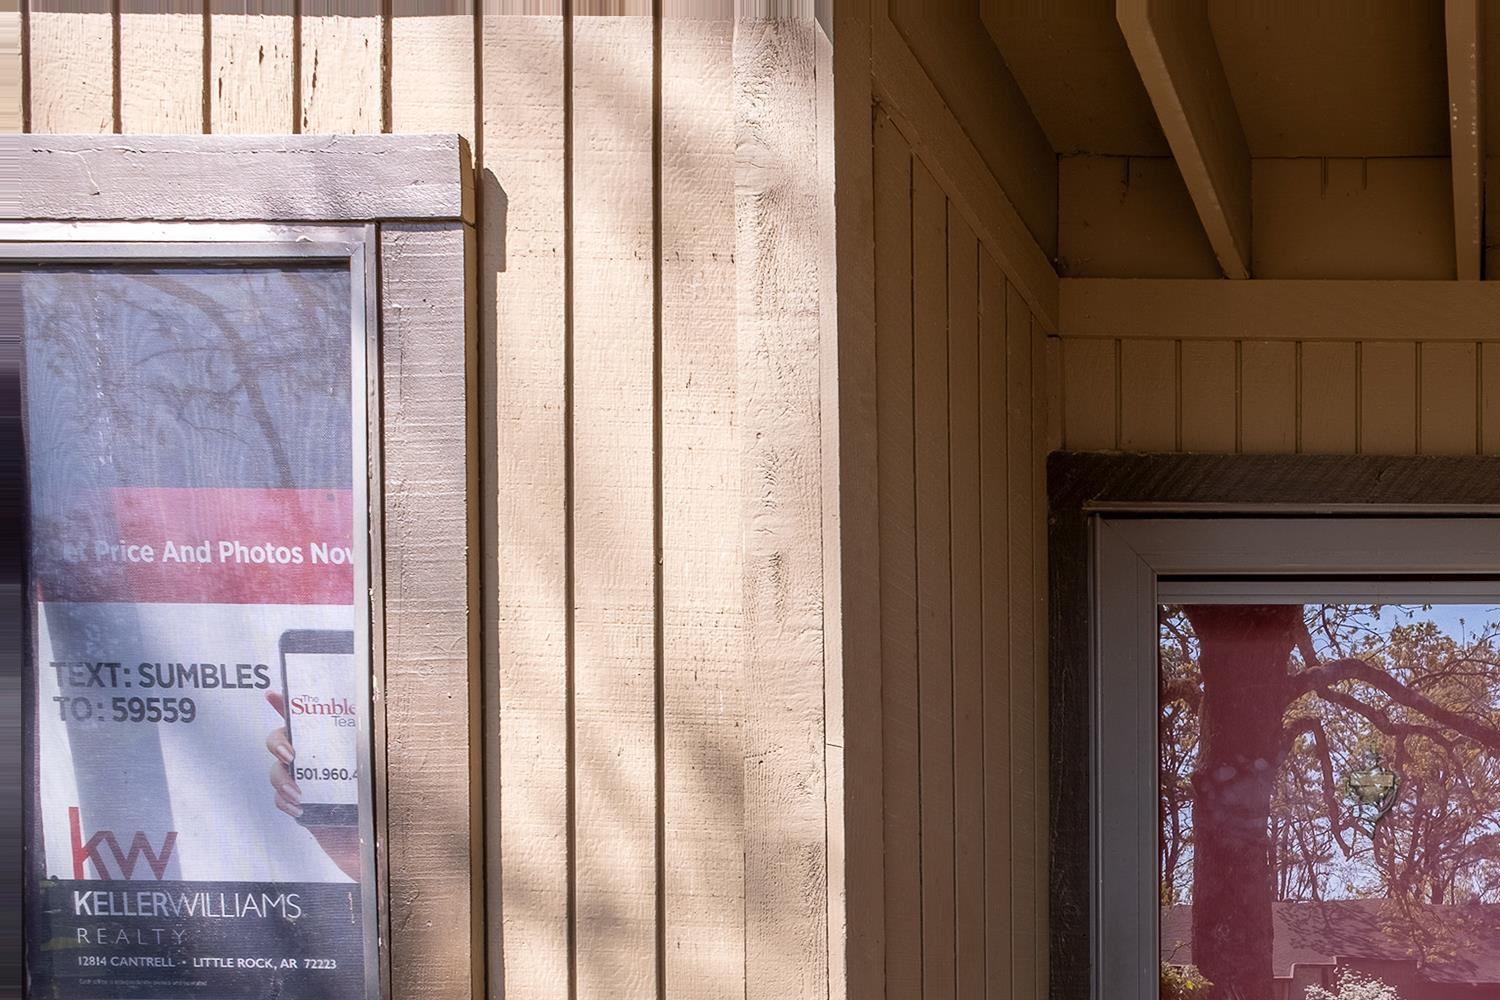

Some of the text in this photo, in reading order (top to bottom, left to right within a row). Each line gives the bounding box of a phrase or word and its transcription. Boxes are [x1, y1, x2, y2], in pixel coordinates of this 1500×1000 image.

[95, 539, 154, 563] Price
[162, 541, 212, 563] And
[220, 541, 303, 564] Photos
[50, 662, 271, 689] TEXT: SUMBLES
[112, 697, 197, 723] 59559
[77, 927, 186, 945] REALTY
[78, 956, 337, 970] 12814 CANTRELL LITTLE ROCK, AR 72223
